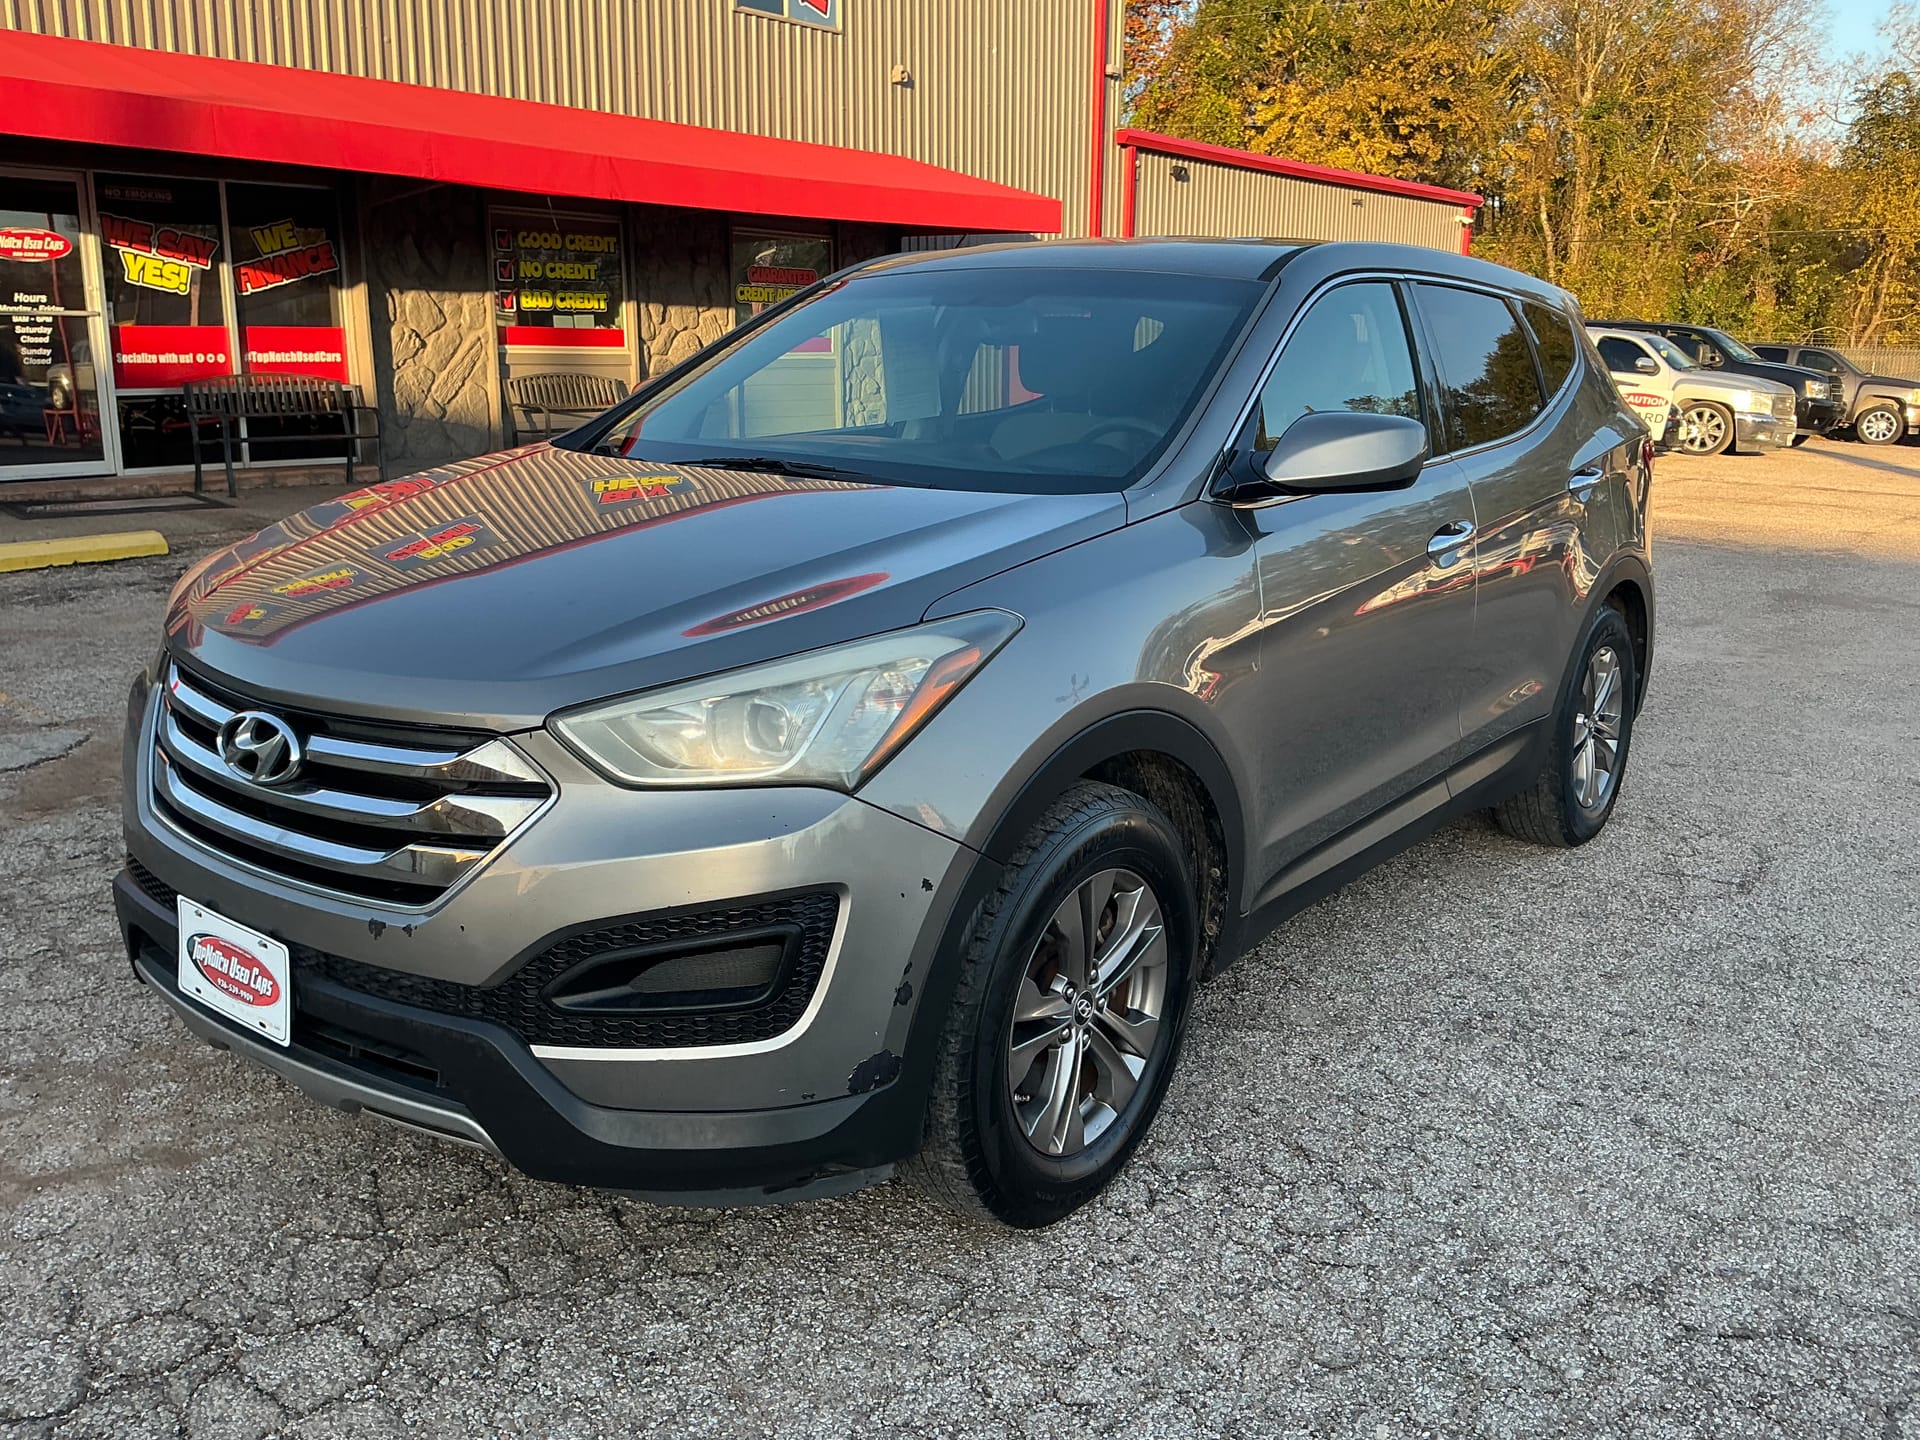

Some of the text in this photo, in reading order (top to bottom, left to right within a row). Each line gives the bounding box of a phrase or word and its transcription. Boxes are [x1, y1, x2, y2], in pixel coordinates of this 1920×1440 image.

[104, 187, 173, 200] NO SMOKING
[101, 214, 216, 267] WE SAY
[253, 222, 298, 254] WE
[517, 231, 617, 253] GOOD CREDIT
[122, 251, 189, 292] YES!
[233, 243, 338, 293] FINANCE
[520, 261, 597, 280] NO CREDIT
[749, 266, 816, 285] GUARANTEED
[13, 292, 48, 303] Hours
[520, 290, 607, 309] BAD CREDIT
[737, 286, 774, 302] CREDIT
[15, 325, 53, 335] Saturday
[20, 335, 50, 343] Closed
[20, 347, 52, 356] Sunday
[116, 352, 193, 364] Socialize with us!
[23, 356, 52, 365] Closed
